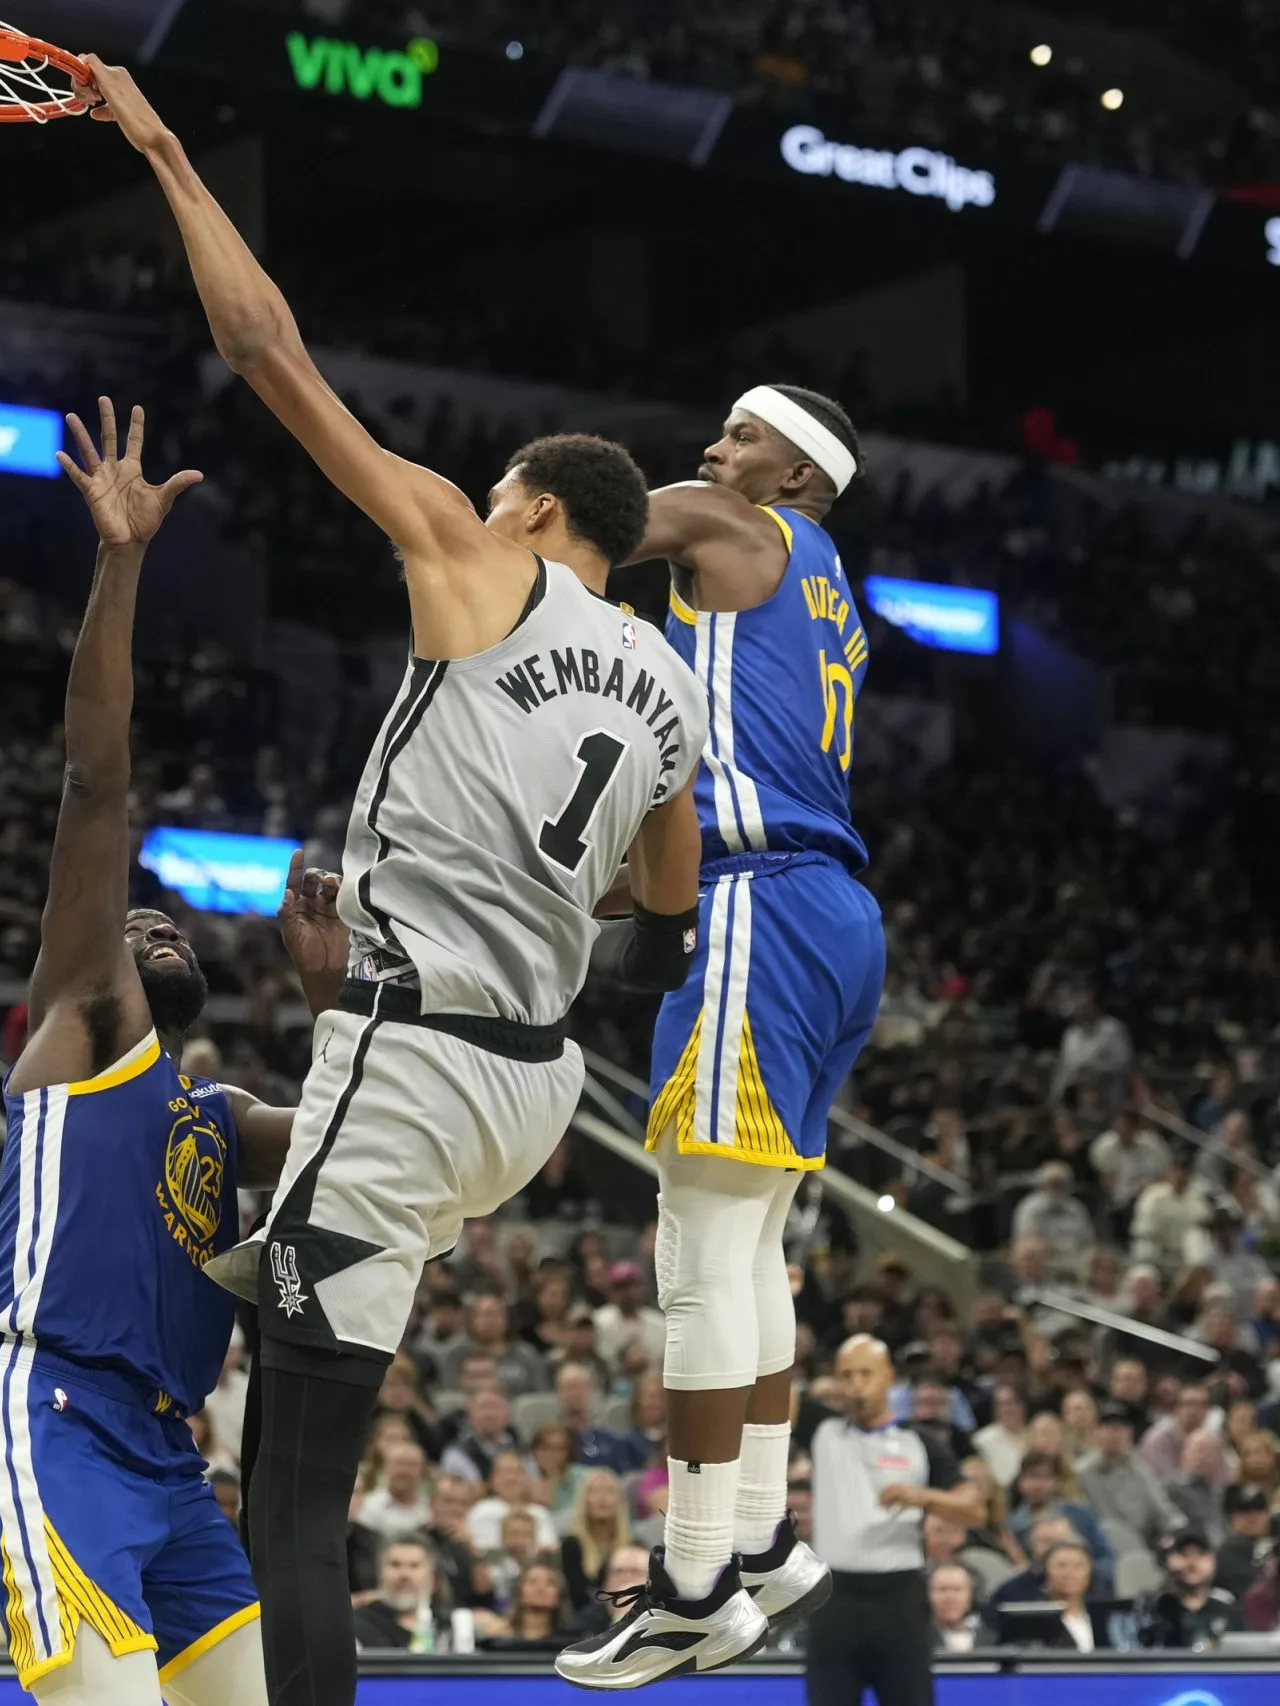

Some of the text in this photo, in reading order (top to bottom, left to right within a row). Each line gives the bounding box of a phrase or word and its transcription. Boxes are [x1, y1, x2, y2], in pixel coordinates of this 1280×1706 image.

[780, 125, 996, 212] Great Clips
[536, 726, 632, 879] 1
[200, 1156, 222, 1198] 23
